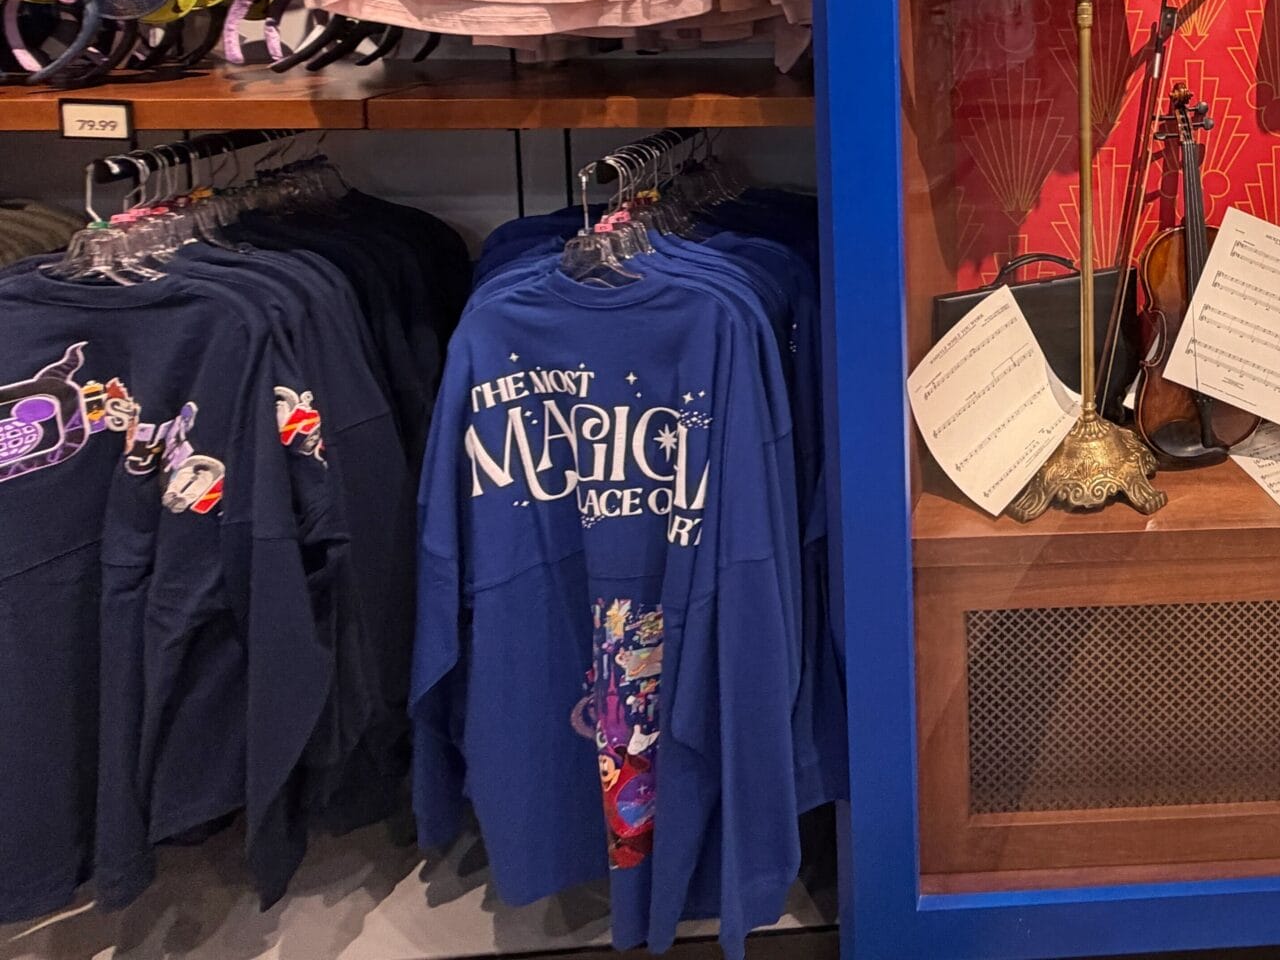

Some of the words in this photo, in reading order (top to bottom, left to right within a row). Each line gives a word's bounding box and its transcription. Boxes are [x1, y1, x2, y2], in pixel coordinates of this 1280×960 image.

[75, 119, 118, 132] 79.99
[471, 372, 529, 412] THE
[529, 370, 594, 398] MOST
